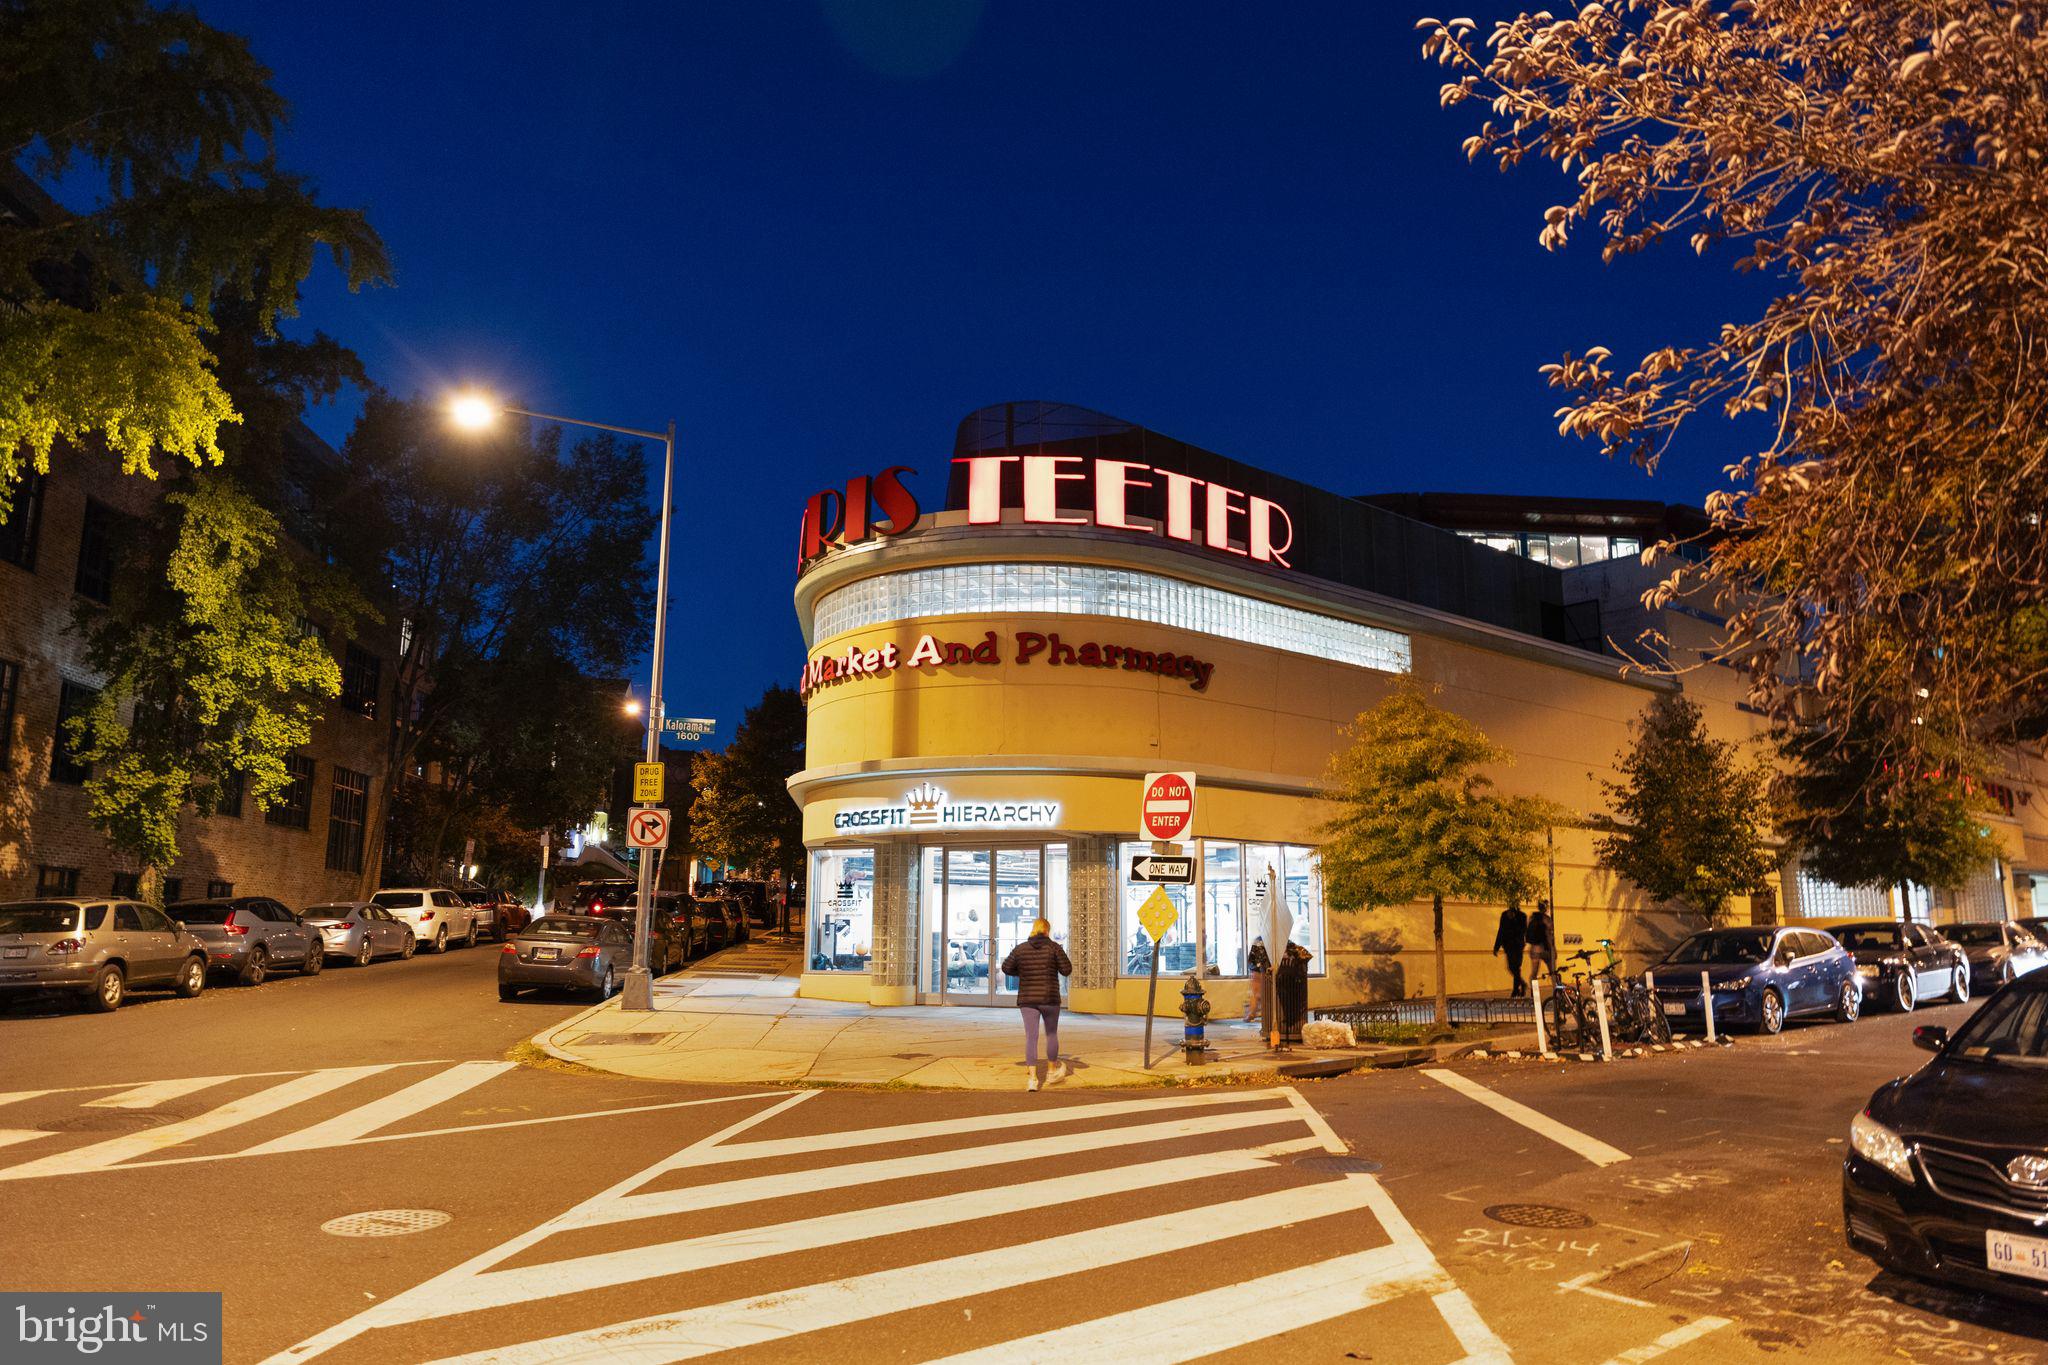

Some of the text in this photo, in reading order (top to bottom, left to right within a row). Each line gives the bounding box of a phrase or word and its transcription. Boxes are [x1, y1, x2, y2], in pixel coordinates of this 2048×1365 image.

[951, 455, 1293, 569] TEETER
[809, 642, 899, 690] Market
[907, 631, 1001, 668] And
[1015, 632, 1214, 693] Pharmacy
[666, 719, 703, 732] Kalorama
[676, 732, 700, 741] 1600
[640, 767, 660, 776] DRUG
[640, 778, 658, 786] FREE
[640, 789, 657, 797] ZONE
[1151, 786, 1187, 797] DO NOT
[834, 805, 1056, 829] CROSSFIT HIERARCHY
[1152, 815, 1180, 827] ENTER
[1149, 863, 1185, 875] ONE WAY
[827, 899, 862, 907] CROSSFIT
